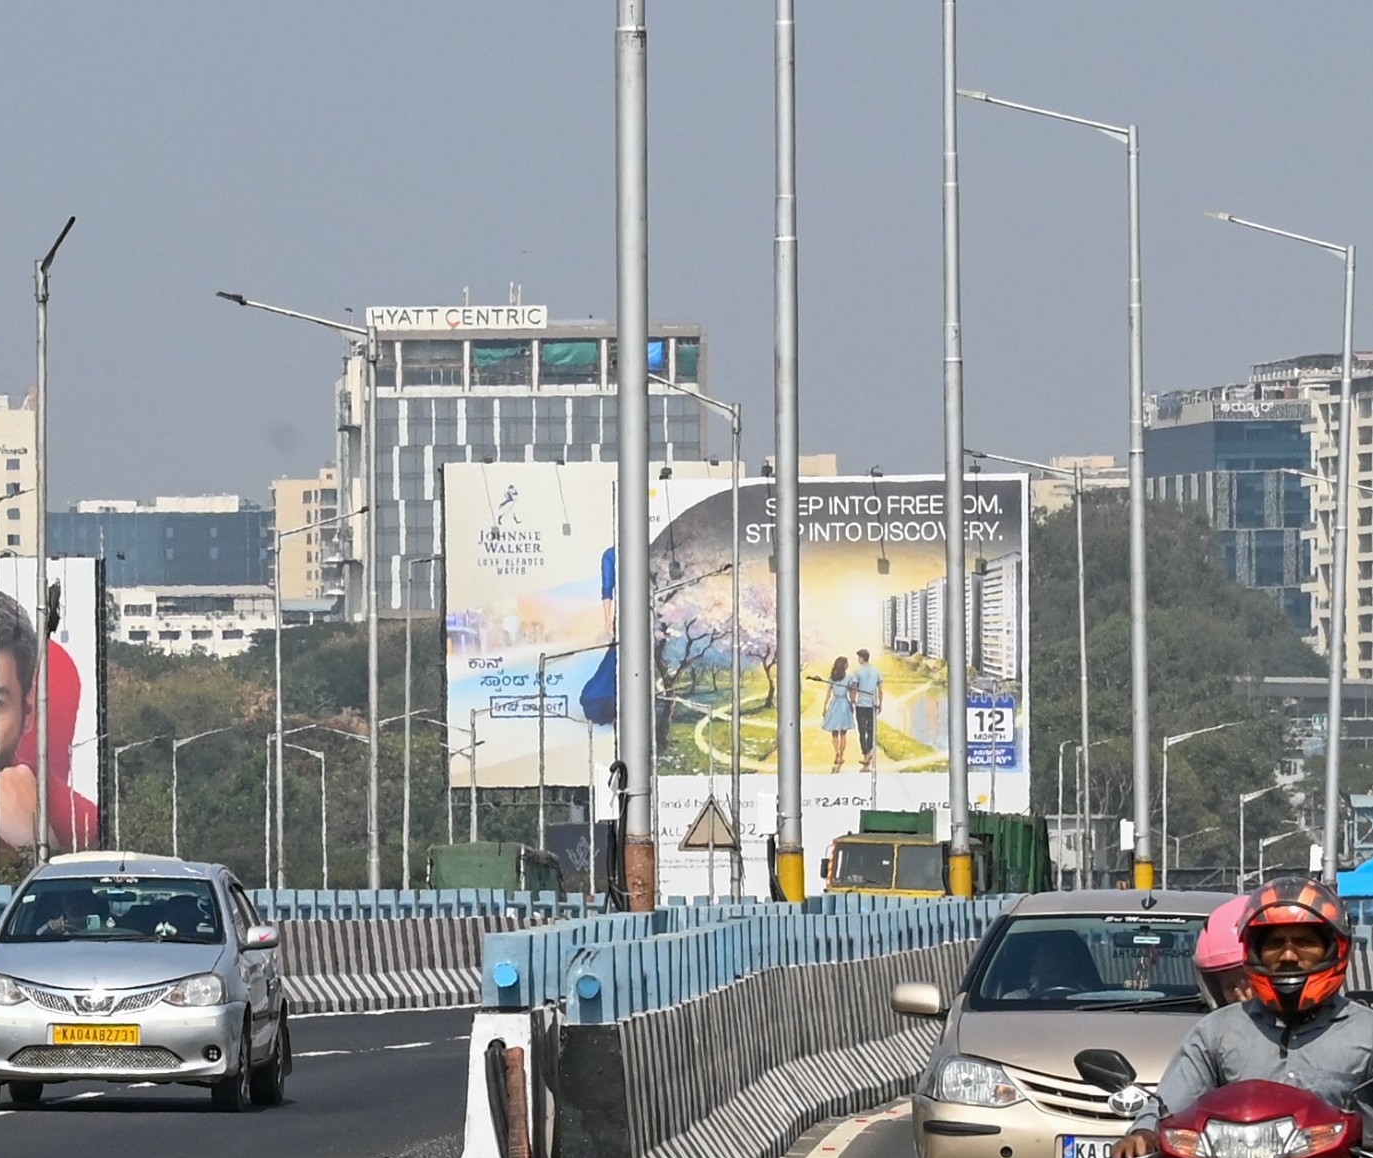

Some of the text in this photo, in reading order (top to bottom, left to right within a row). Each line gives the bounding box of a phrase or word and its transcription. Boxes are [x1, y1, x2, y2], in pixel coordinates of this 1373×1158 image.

[371, 308, 542, 328] HYATT CENTRIC
[765, 494, 1003, 517] SEP INTO FREEOM.
[477, 529, 542, 545] JOHNNIE
[809, 522, 863, 542] INTO
[483, 542, 543, 554] WALKER
[974, 710, 1005, 732] 12
[973, 732, 1007, 741] MONTH
[967, 755, 1013, 767] HOLIAY
